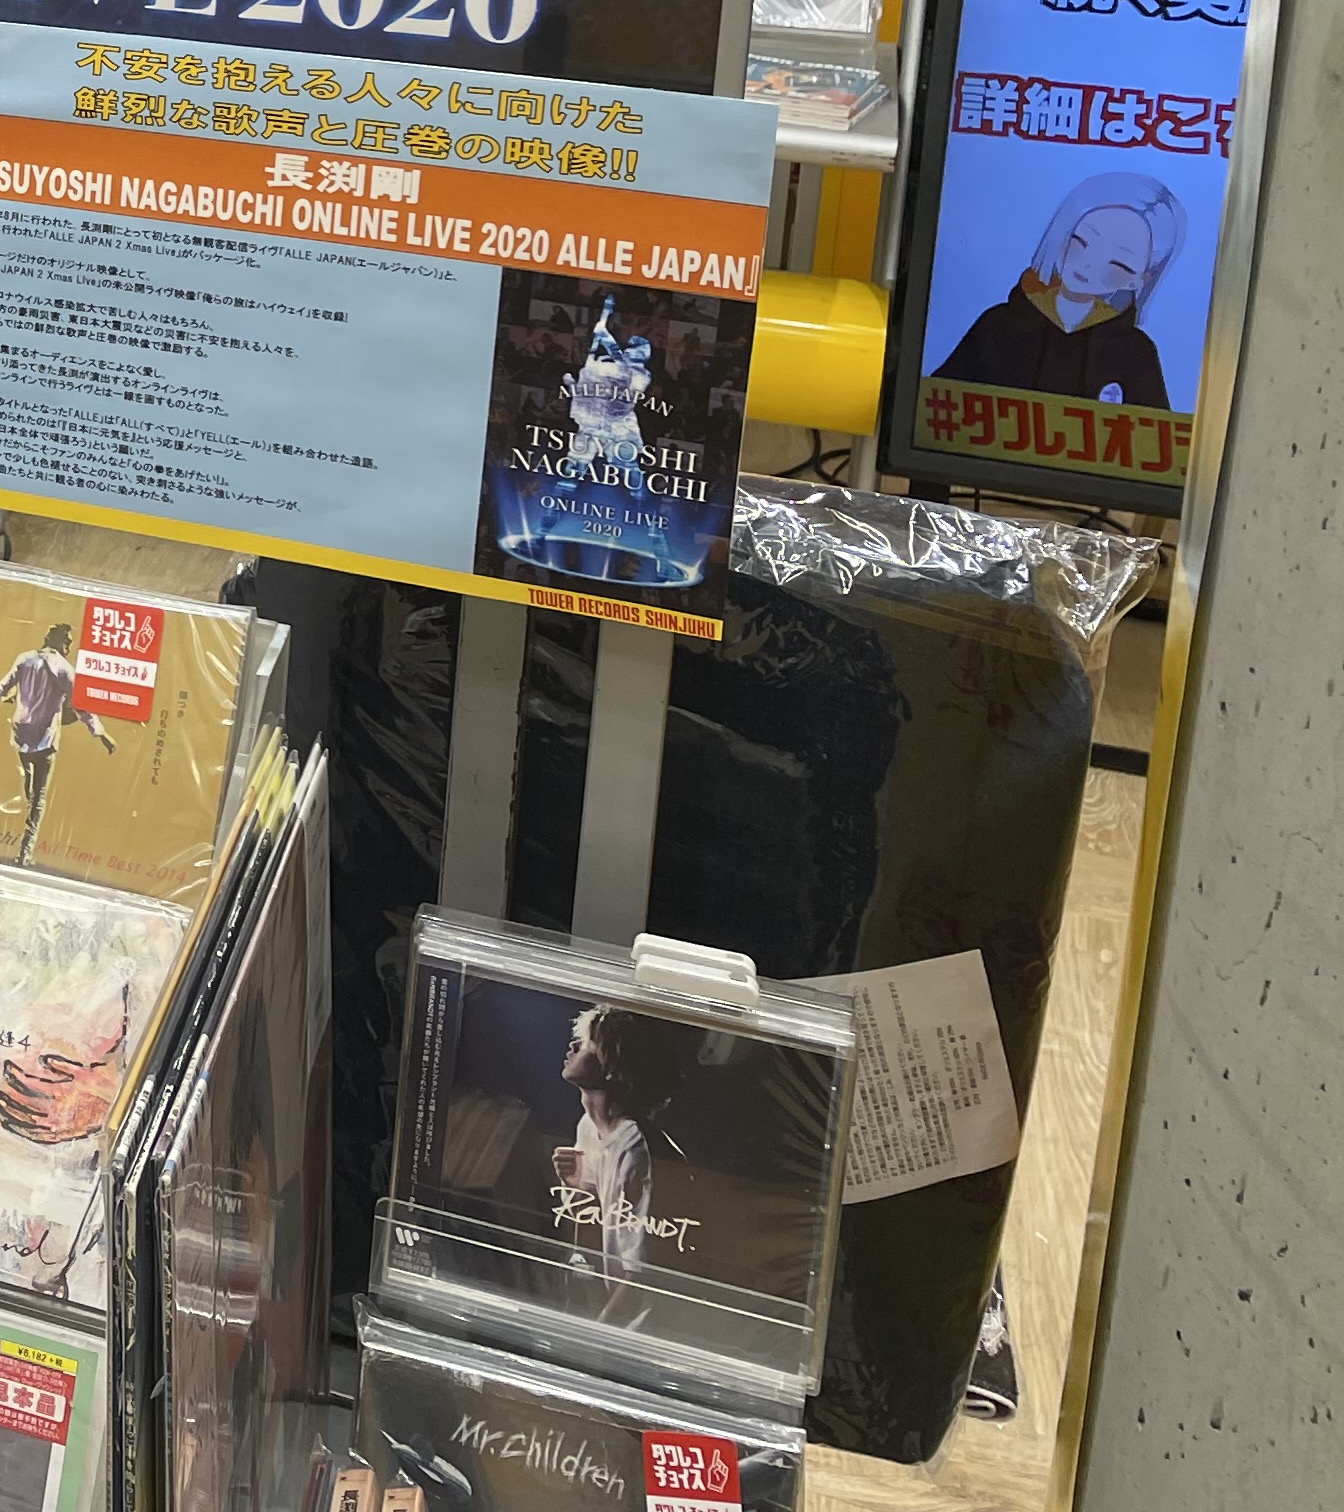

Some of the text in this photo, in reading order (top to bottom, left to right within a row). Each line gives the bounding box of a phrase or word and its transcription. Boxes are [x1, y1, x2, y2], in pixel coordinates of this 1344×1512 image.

[75, 41, 644, 135] 不安を抱える人々に向けた
[73, 86, 639, 182] 鮮烈な歌声と圧巻の映像!!
[264, 153, 421, 205] 長渕剛
[78, 235, 112, 248] JAPAN
[120, 176, 284, 229] NAGABUCHI
[292, 197, 398, 243] ONLINE
[406, 212, 472, 253] LIVE
[479, 222, 550, 263] 2020
[557, 233, 635, 276] ALLE
[641, 244, 760, 297] JAPAN』
[0, 263, 34, 277] JAPAN
[558, 383, 674, 417] ALLE JAPAN
[525, 424, 698, 474] TSUYOSHI
[509, 448, 708, 503] NAGABUCHI
[540, 495, 669, 531] ONLINE LIVE
[582, 520, 622, 539] 2020
[93, 606, 135, 631] タワレコ
[528, 588, 716, 639] TOWER RECORDS SHINJUKU
[92, 625, 133, 650] チョイス
[85, 657, 139, 679] タワレコ チョイス
[36, 840, 186, 884] All Time Best 2014
[450, 1413, 626, 1501] Mr.Children
[650, 1443, 705, 1468] タワレコ
[652, 1468, 707, 1492] チョイス
